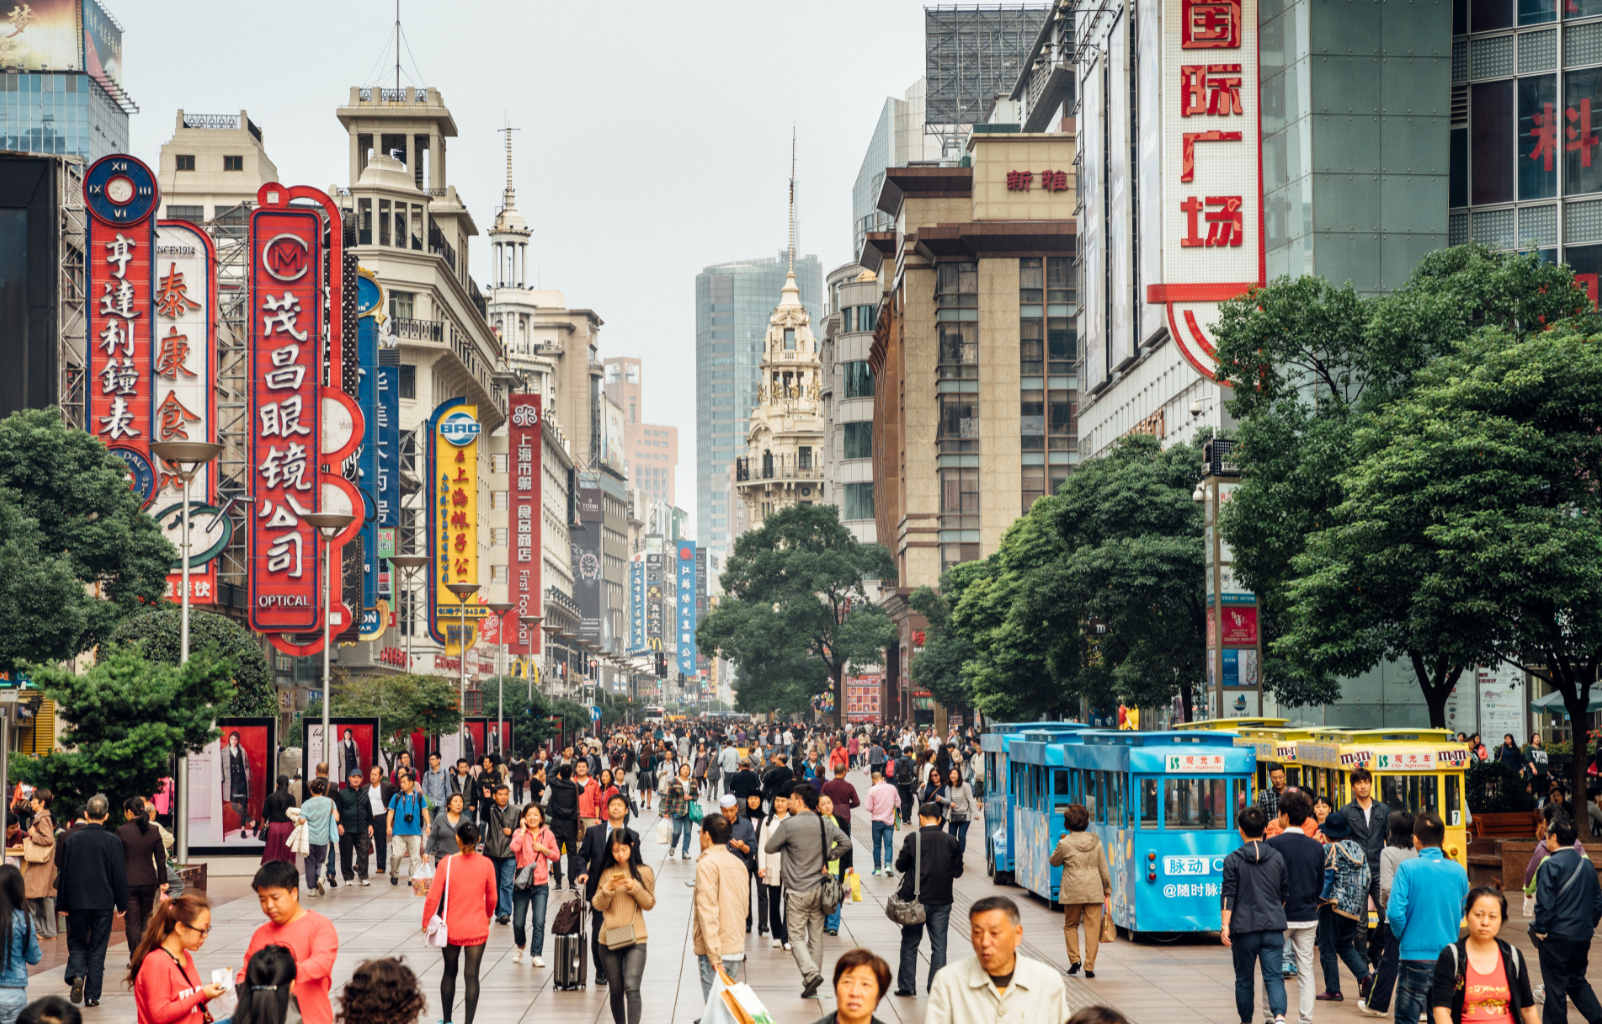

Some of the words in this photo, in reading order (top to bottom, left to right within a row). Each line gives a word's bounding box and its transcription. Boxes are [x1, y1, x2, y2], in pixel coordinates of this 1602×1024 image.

[6, 4, 34, 38] 梦
[1180, 0, 1243, 248] 国际广场
[1530, 98, 1599, 172] 料
[1006, 169, 1068, 191] 新雅
[113, 208, 127, 218] VI
[99, 232, 143, 440] 亨達利鐘表
[156, 262, 202, 491] 泰康食
[258, 290, 312, 579] 茂昌眼镜公司
[440, 423, 481, 434] BAC
[517, 433, 532, 562] 上海市第一食品商店
[519, 569, 530, 592] First
[258, 593, 312, 608] OPTICAL
[518, 594, 530, 645] Foohall
[1186, 755, 1222, 765] 观光车
[1394, 754, 1432, 763] 观光车
[1453, 812, 1459, 824] 7
[1169, 858, 1203, 874] 脉动
